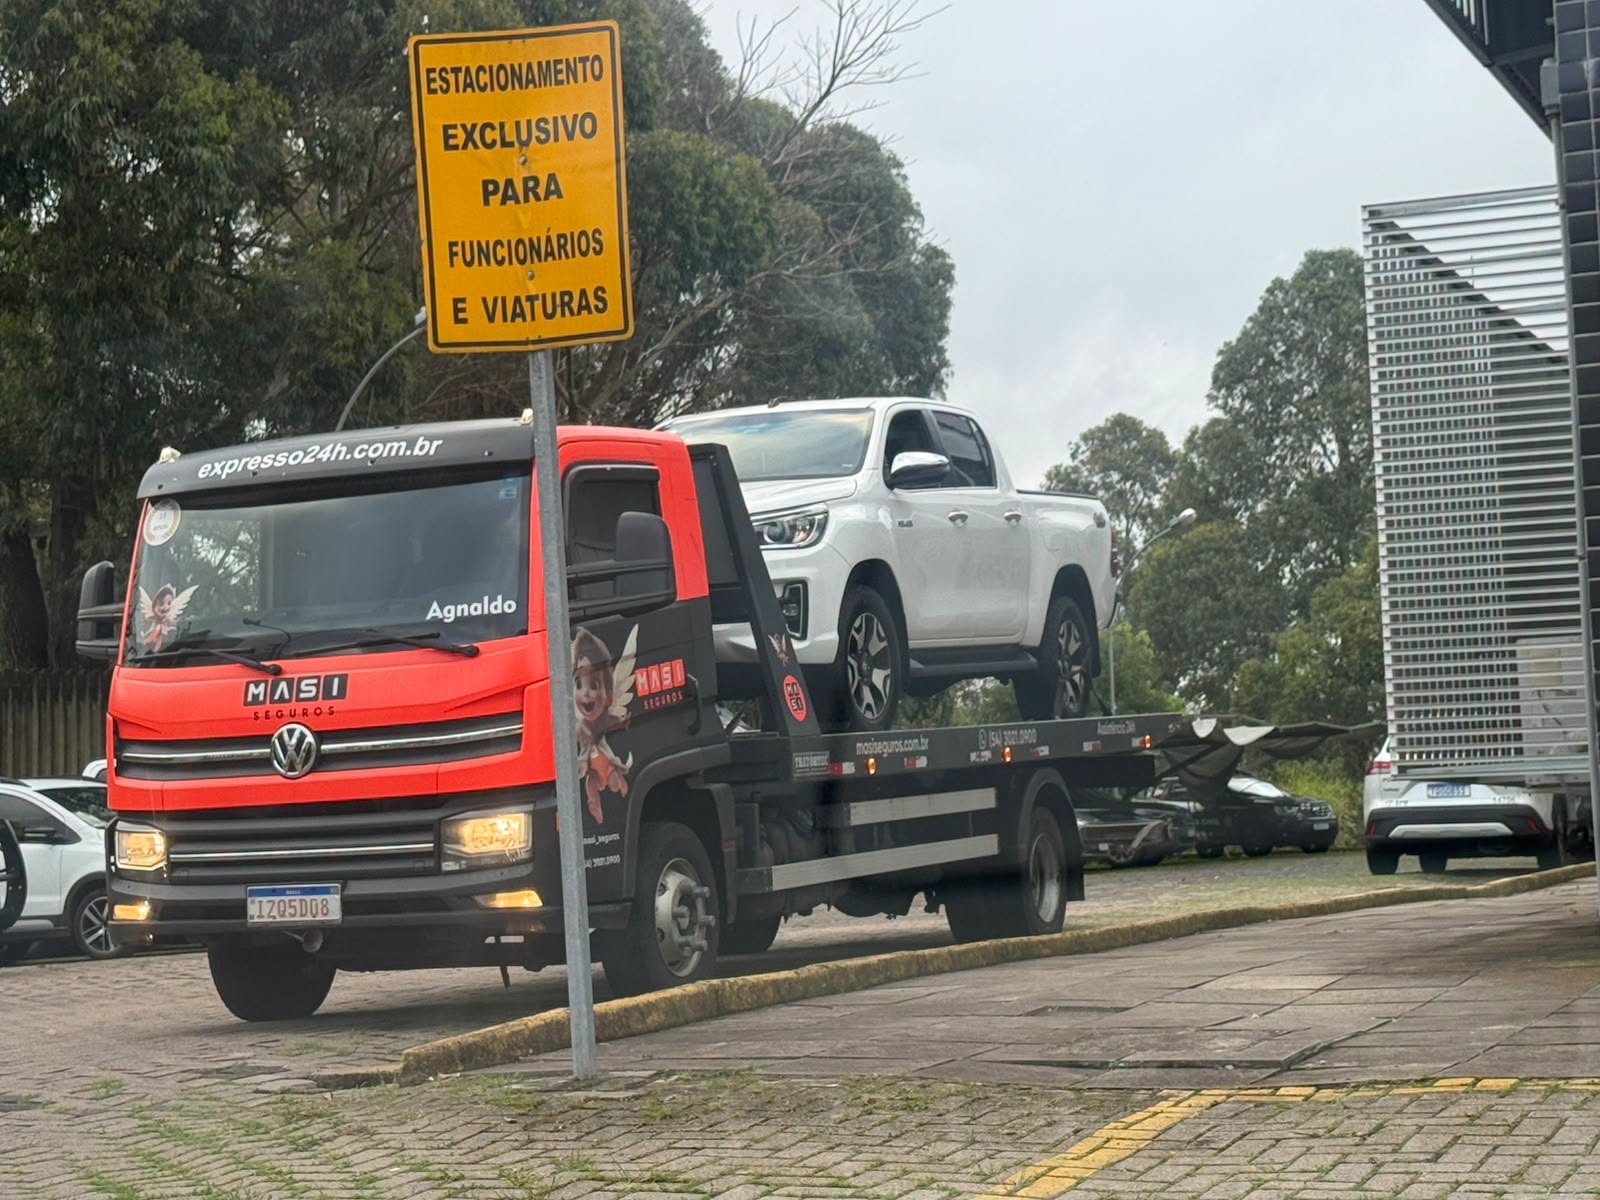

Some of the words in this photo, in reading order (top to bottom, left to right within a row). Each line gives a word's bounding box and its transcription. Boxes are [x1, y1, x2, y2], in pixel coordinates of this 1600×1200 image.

[425, 54, 604, 95] ESTACIONAMENTO
[442, 112, 598, 152] EXCLUSIVO
[481, 173, 564, 207] PARA
[449, 227, 604, 268] FUNCIONÁRIOS
[452, 297, 469, 325] E
[481, 285, 609, 325] VIATURAS
[198, 436, 443, 480] expresso24h.com.br
[426, 594, 517, 623] Agnaldo
[245, 675, 342, 704] MASI
[636, 661, 684, 692] MASI
[253, 706, 335, 720] SEGUROS
[643, 690, 683, 710] SEGUROS
[256, 897, 330, 920] IZQ5D08
